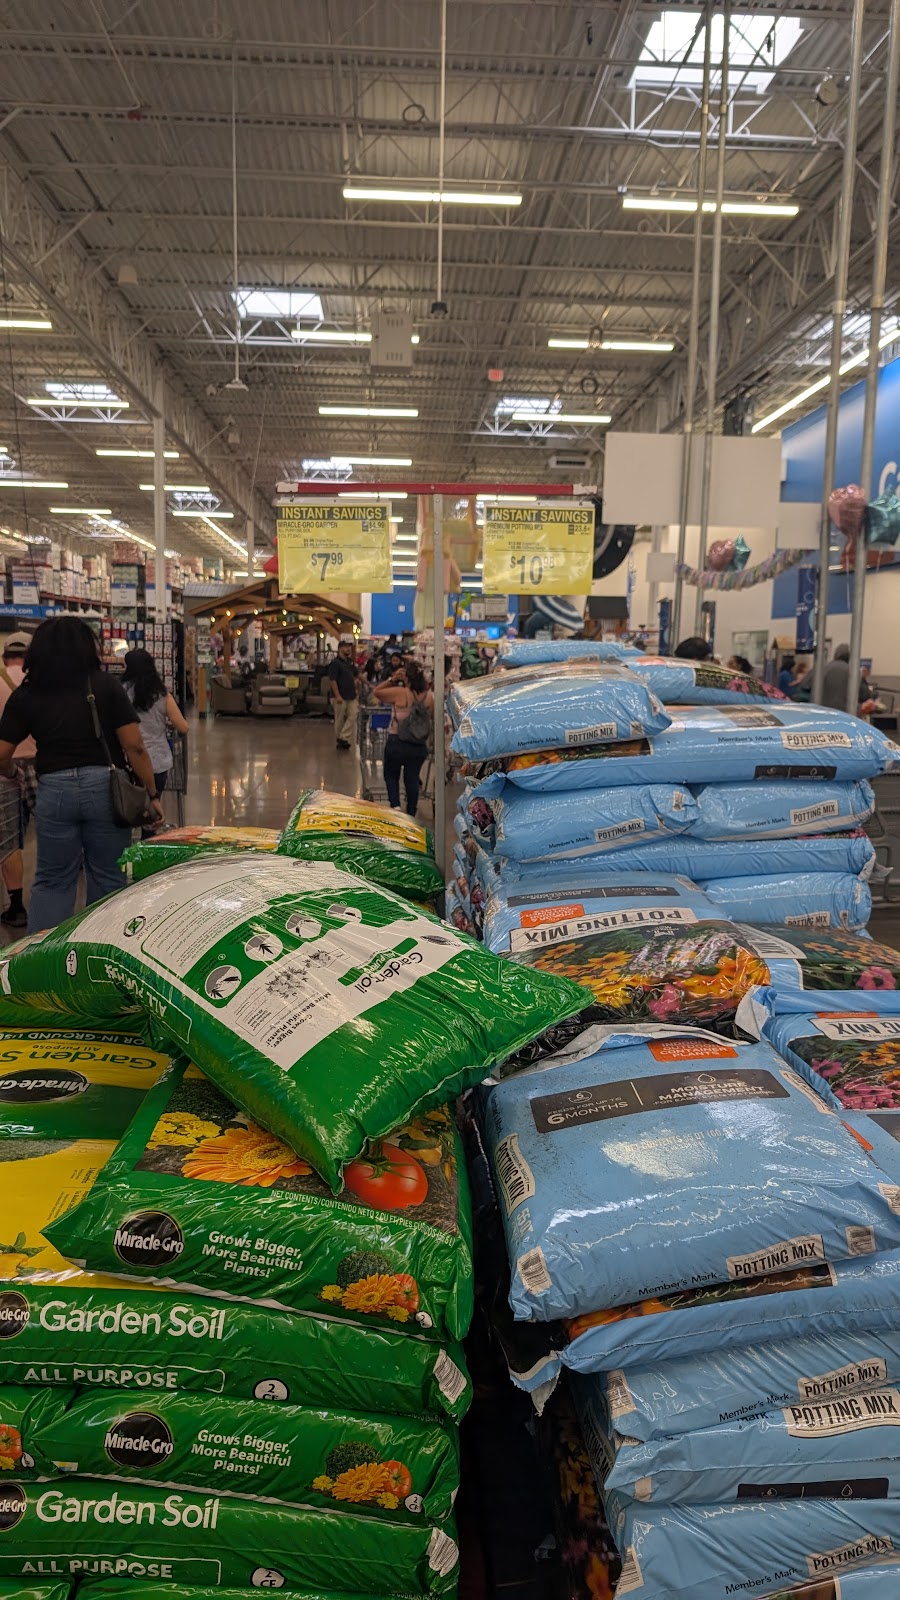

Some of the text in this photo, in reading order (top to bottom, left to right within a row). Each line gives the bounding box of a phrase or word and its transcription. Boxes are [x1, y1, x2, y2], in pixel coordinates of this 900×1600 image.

[282, 507, 382, 519] INSTANT SAVINGS
[491, 508, 589, 523] INSTANT SAVINGS
[568, 727, 614, 743] POTTING MIX
[786, 734, 846, 744] POTTING MIX
[793, 804, 836, 823] POTTING MIX
[597, 823, 642, 840] POTTING MIX
[576, 909, 682, 932] POTTING
[525, 925, 569, 943] MIX
[28, 1032, 122, 1043] IN-GROUND
[828, 1023, 882, 1035] MIX
[122, 1036, 146, 1046] OR
[660, 1047, 728, 1055] CONTAINER
[28, 1050, 157, 1070] Garden
[658, 1086, 765, 1101] MANAGEMENT
[671, 1081, 748, 1094] MOISTURE
[576, 1102, 594, 1110] FOR
[497, 1142, 519, 1187] POTTING
[507, 1177, 525, 1206] MIX
[271, 1189, 283, 1199] NET
[357, 1206, 374, 1220] NETO
[380, 1212, 389, 1222] CU
[114, 1230, 184, 1254] Miracle-Gro
[208, 1230, 302, 1259] Grows Bigger,
[201, 1244, 304, 1271] More Beautiful
[734, 1242, 818, 1277] POTTING MIX
[638, 1271, 718, 1296] Member's Mark
[39, 1300, 162, 1335] Garden
[167, 1305, 226, 1340] Soil
[24, 1367, 179, 1389] ALL PURPOSE
[267, 1383, 276, 1394] 2
[805, 1372, 856, 1398] POTTING
[857, 1366, 880, 1382] MIX
[719, 1393, 789, 1423] Member's Mark
[790, 1395, 898, 1428] POTTING MIX
[104, 1432, 174, 1455] Miracle-Gro
[197, 1429, 291, 1454] Grows Bigger,
[191, 1443, 292, 1468] More Beautiful
[36, 1491, 156, 1525] Garden
[161, 1495, 220, 1530] Soil
[813, 1537, 889, 1571] POTTING MIX
[21, 1558, 173, 1579] ALL PURPOSE
[265, 1568, 273, 1578] 2
[725, 1567, 799, 1595] Member's Mark
